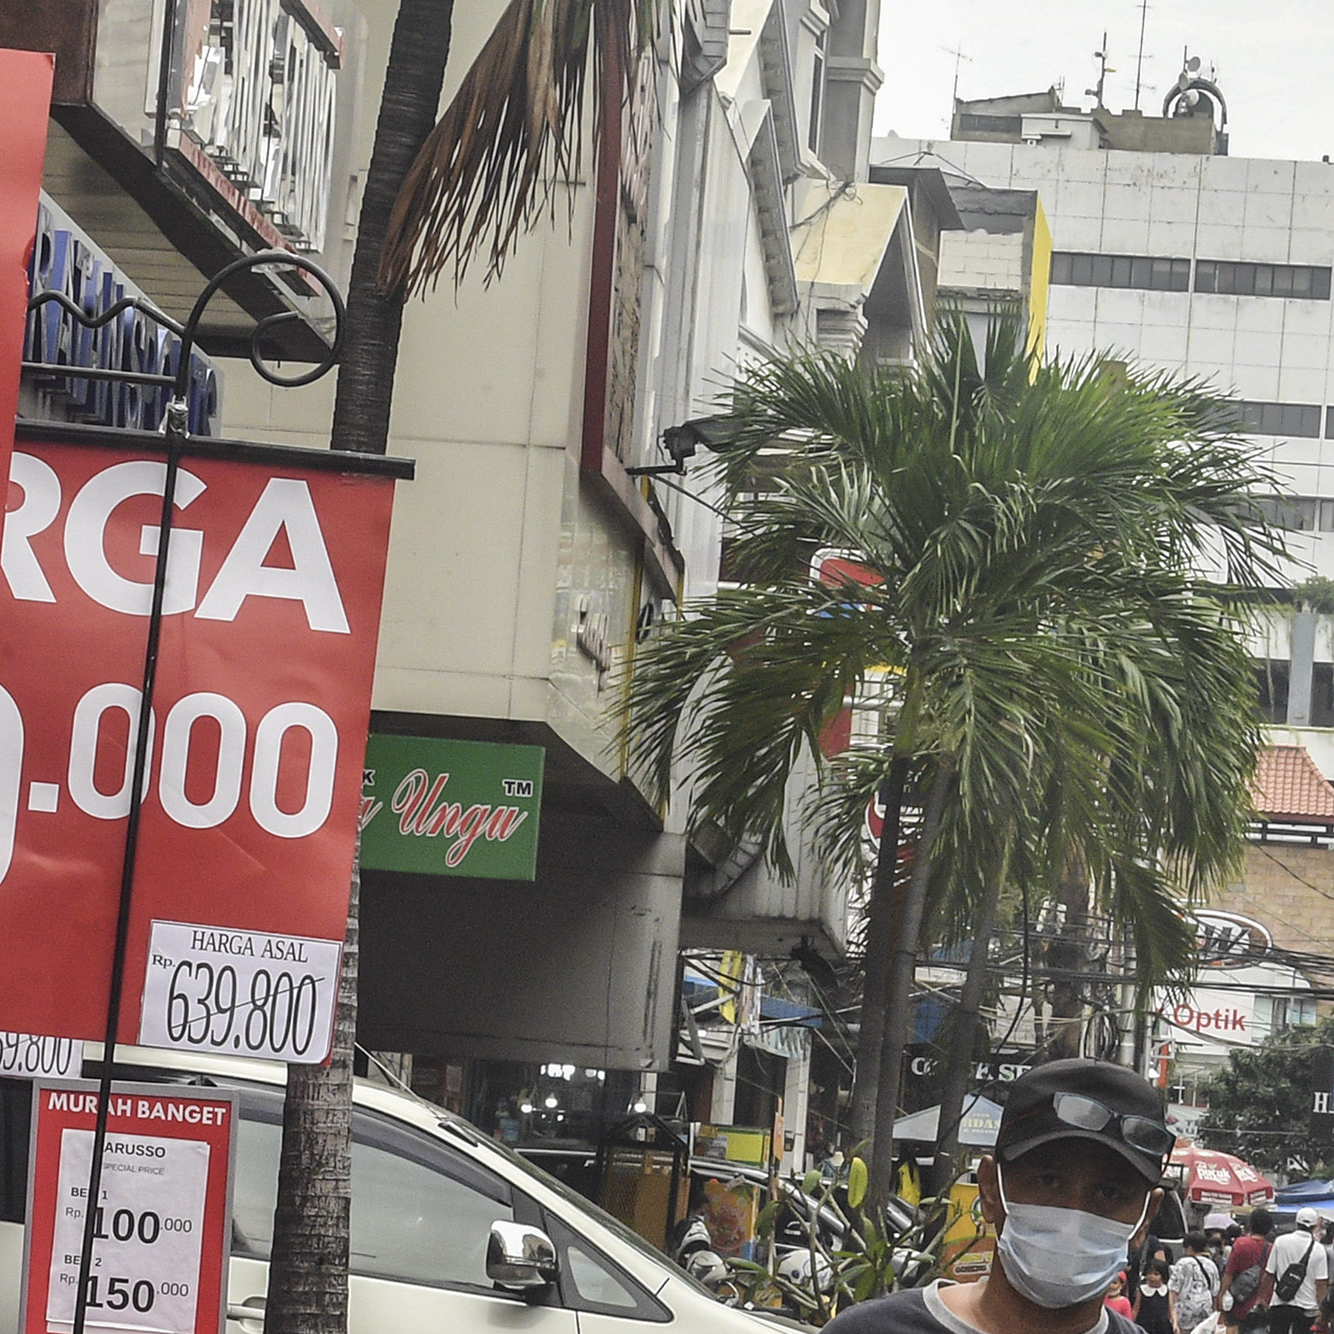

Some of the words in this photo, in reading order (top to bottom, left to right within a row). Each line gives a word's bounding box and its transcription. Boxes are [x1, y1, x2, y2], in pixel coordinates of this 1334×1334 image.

[502, 779, 533, 797] TM
[391, 768, 529, 868] Ungu
[191, 931, 255, 957] HARGA
[261, 941, 308, 964] ASAL
[152, 953, 175, 969] Rp.
[168, 960, 317, 1056] 639.800
[1173, 1003, 1246, 1032] Optik
[137, 1100, 227, 1126] BANGET
[138, 1166, 165, 1176] PRICE
[101, 1190, 108, 1200] 1
[66, 1207, 84, 1219] Rp.
[95, 1257, 102, 1267] 2
